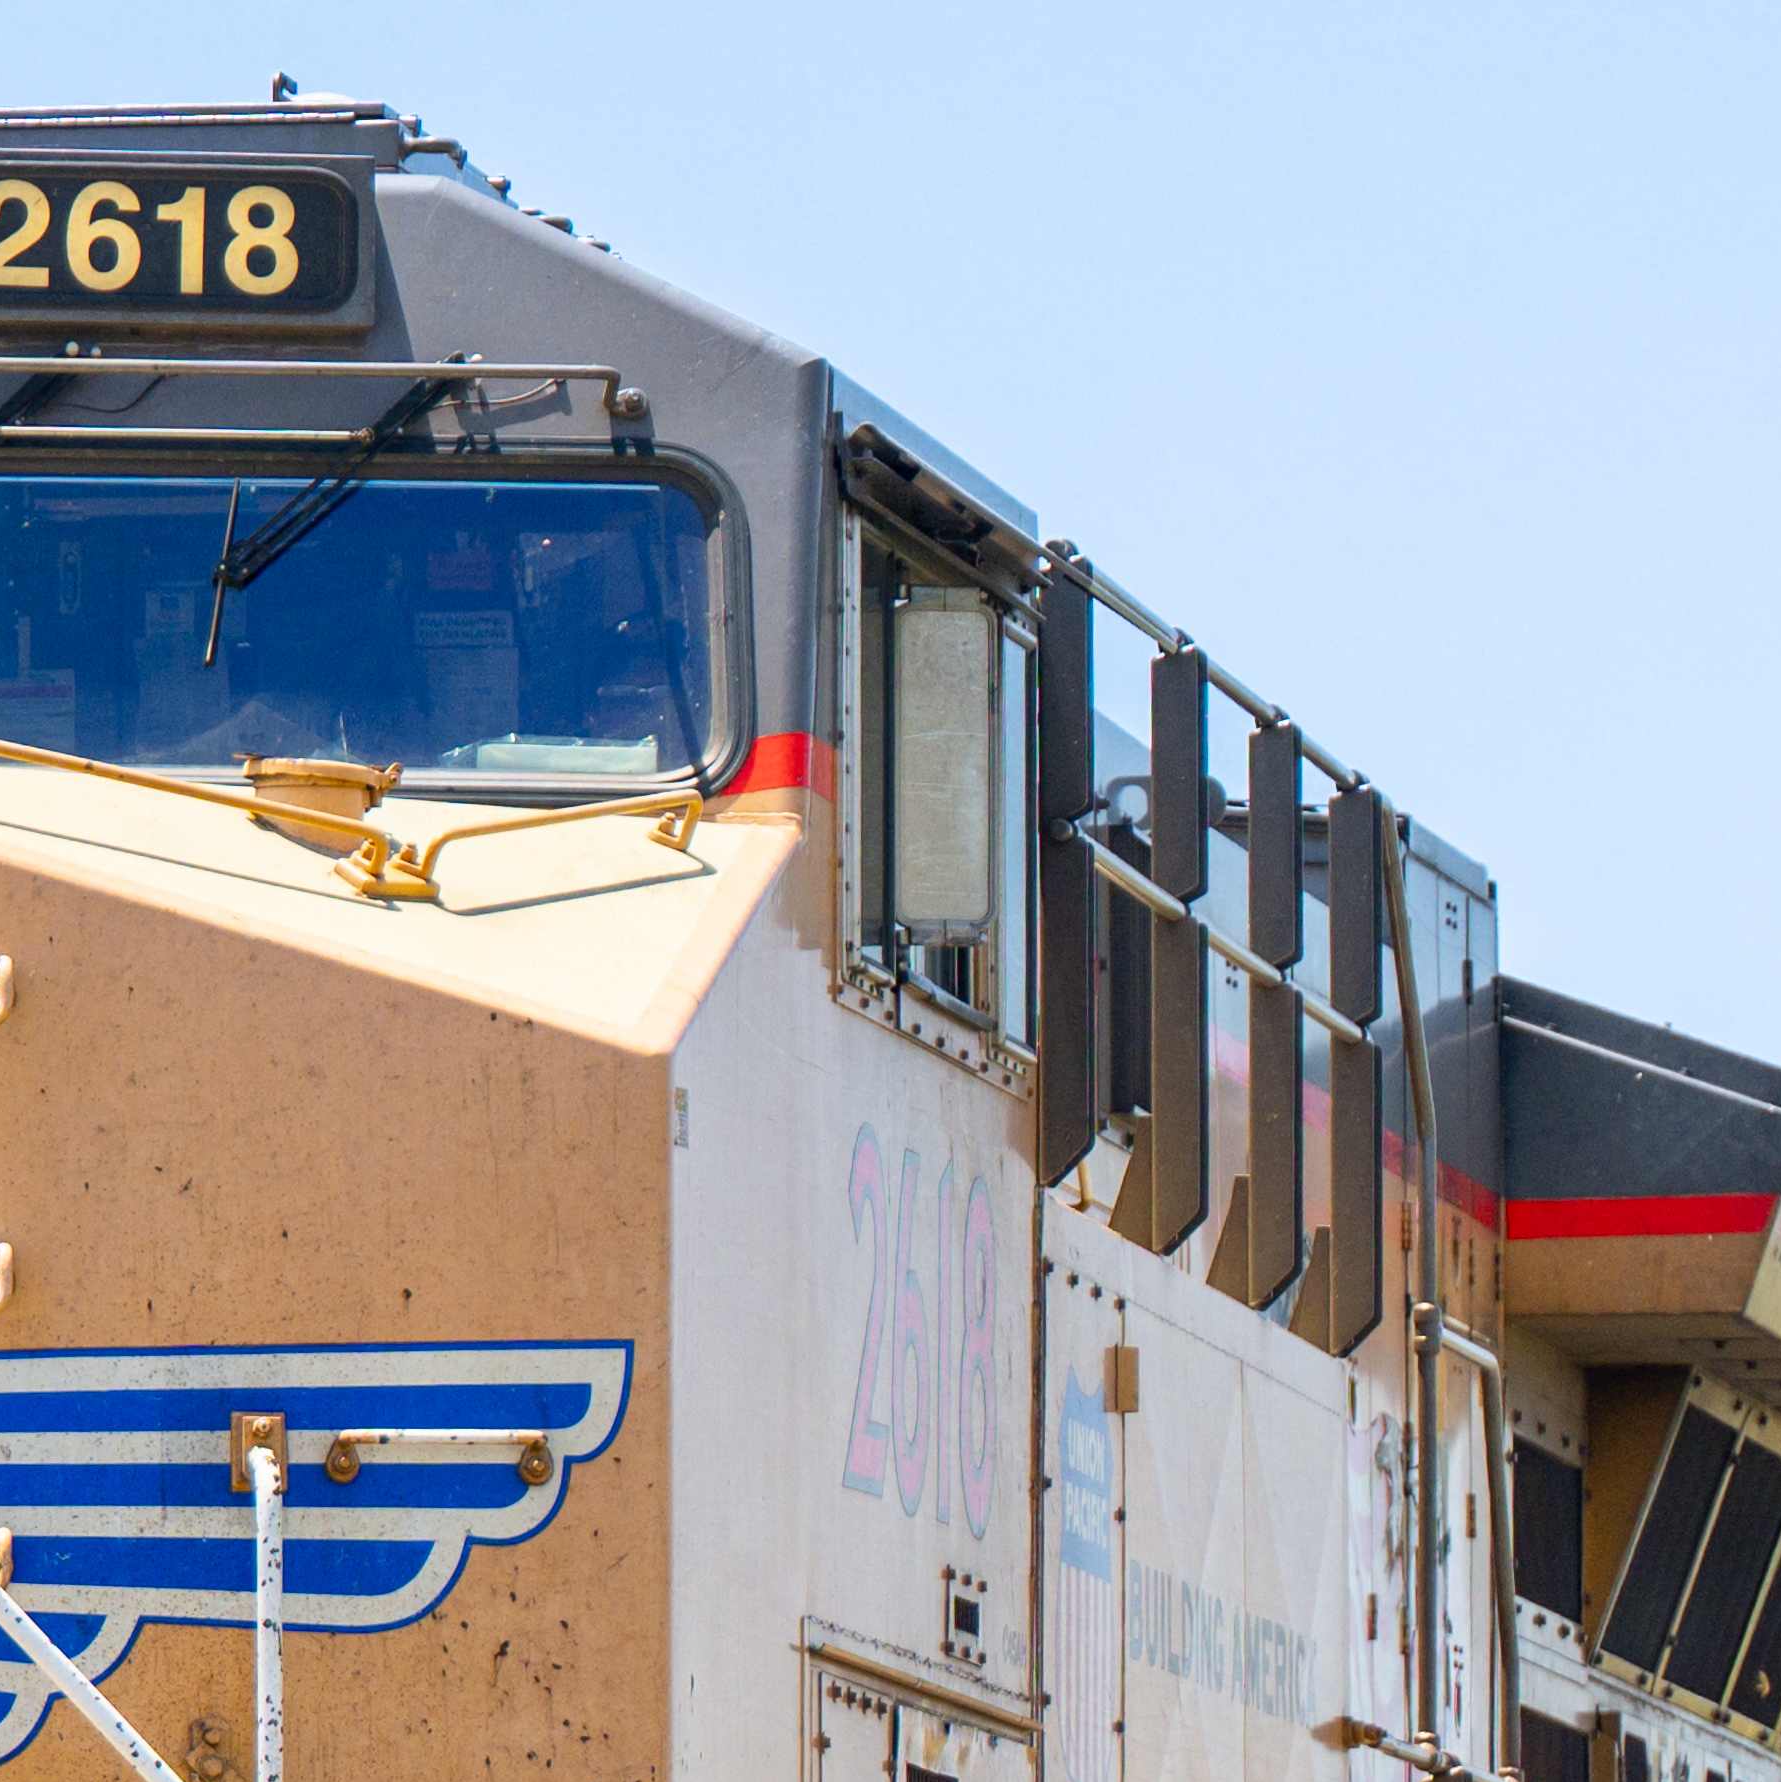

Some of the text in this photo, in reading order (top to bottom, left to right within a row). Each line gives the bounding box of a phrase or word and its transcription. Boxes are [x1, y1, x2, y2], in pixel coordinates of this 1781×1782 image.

[842, 1120, 997, 1541] 2618
[1067, 1417, 1106, 1484] UNION
[1065, 1481, 1108, 1549] PACIFIC
[1129, 1559, 1227, 1694] BUILDING
